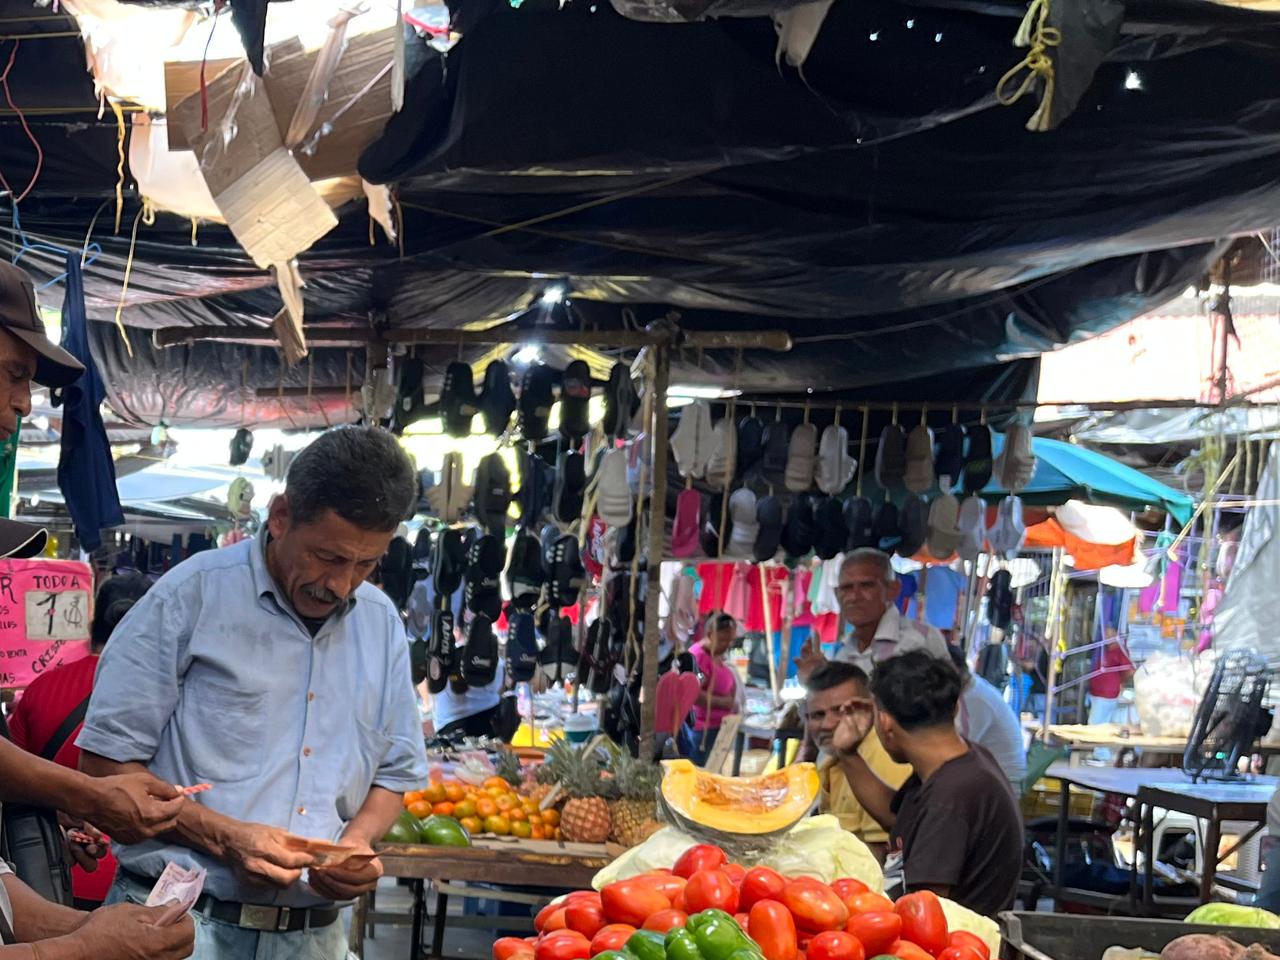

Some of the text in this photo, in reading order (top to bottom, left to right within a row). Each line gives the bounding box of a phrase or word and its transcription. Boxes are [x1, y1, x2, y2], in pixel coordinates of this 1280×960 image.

[33, 575, 80, 589] TODO A
[36, 593, 56, 635] 1
[0, 673, 16, 684] AS
